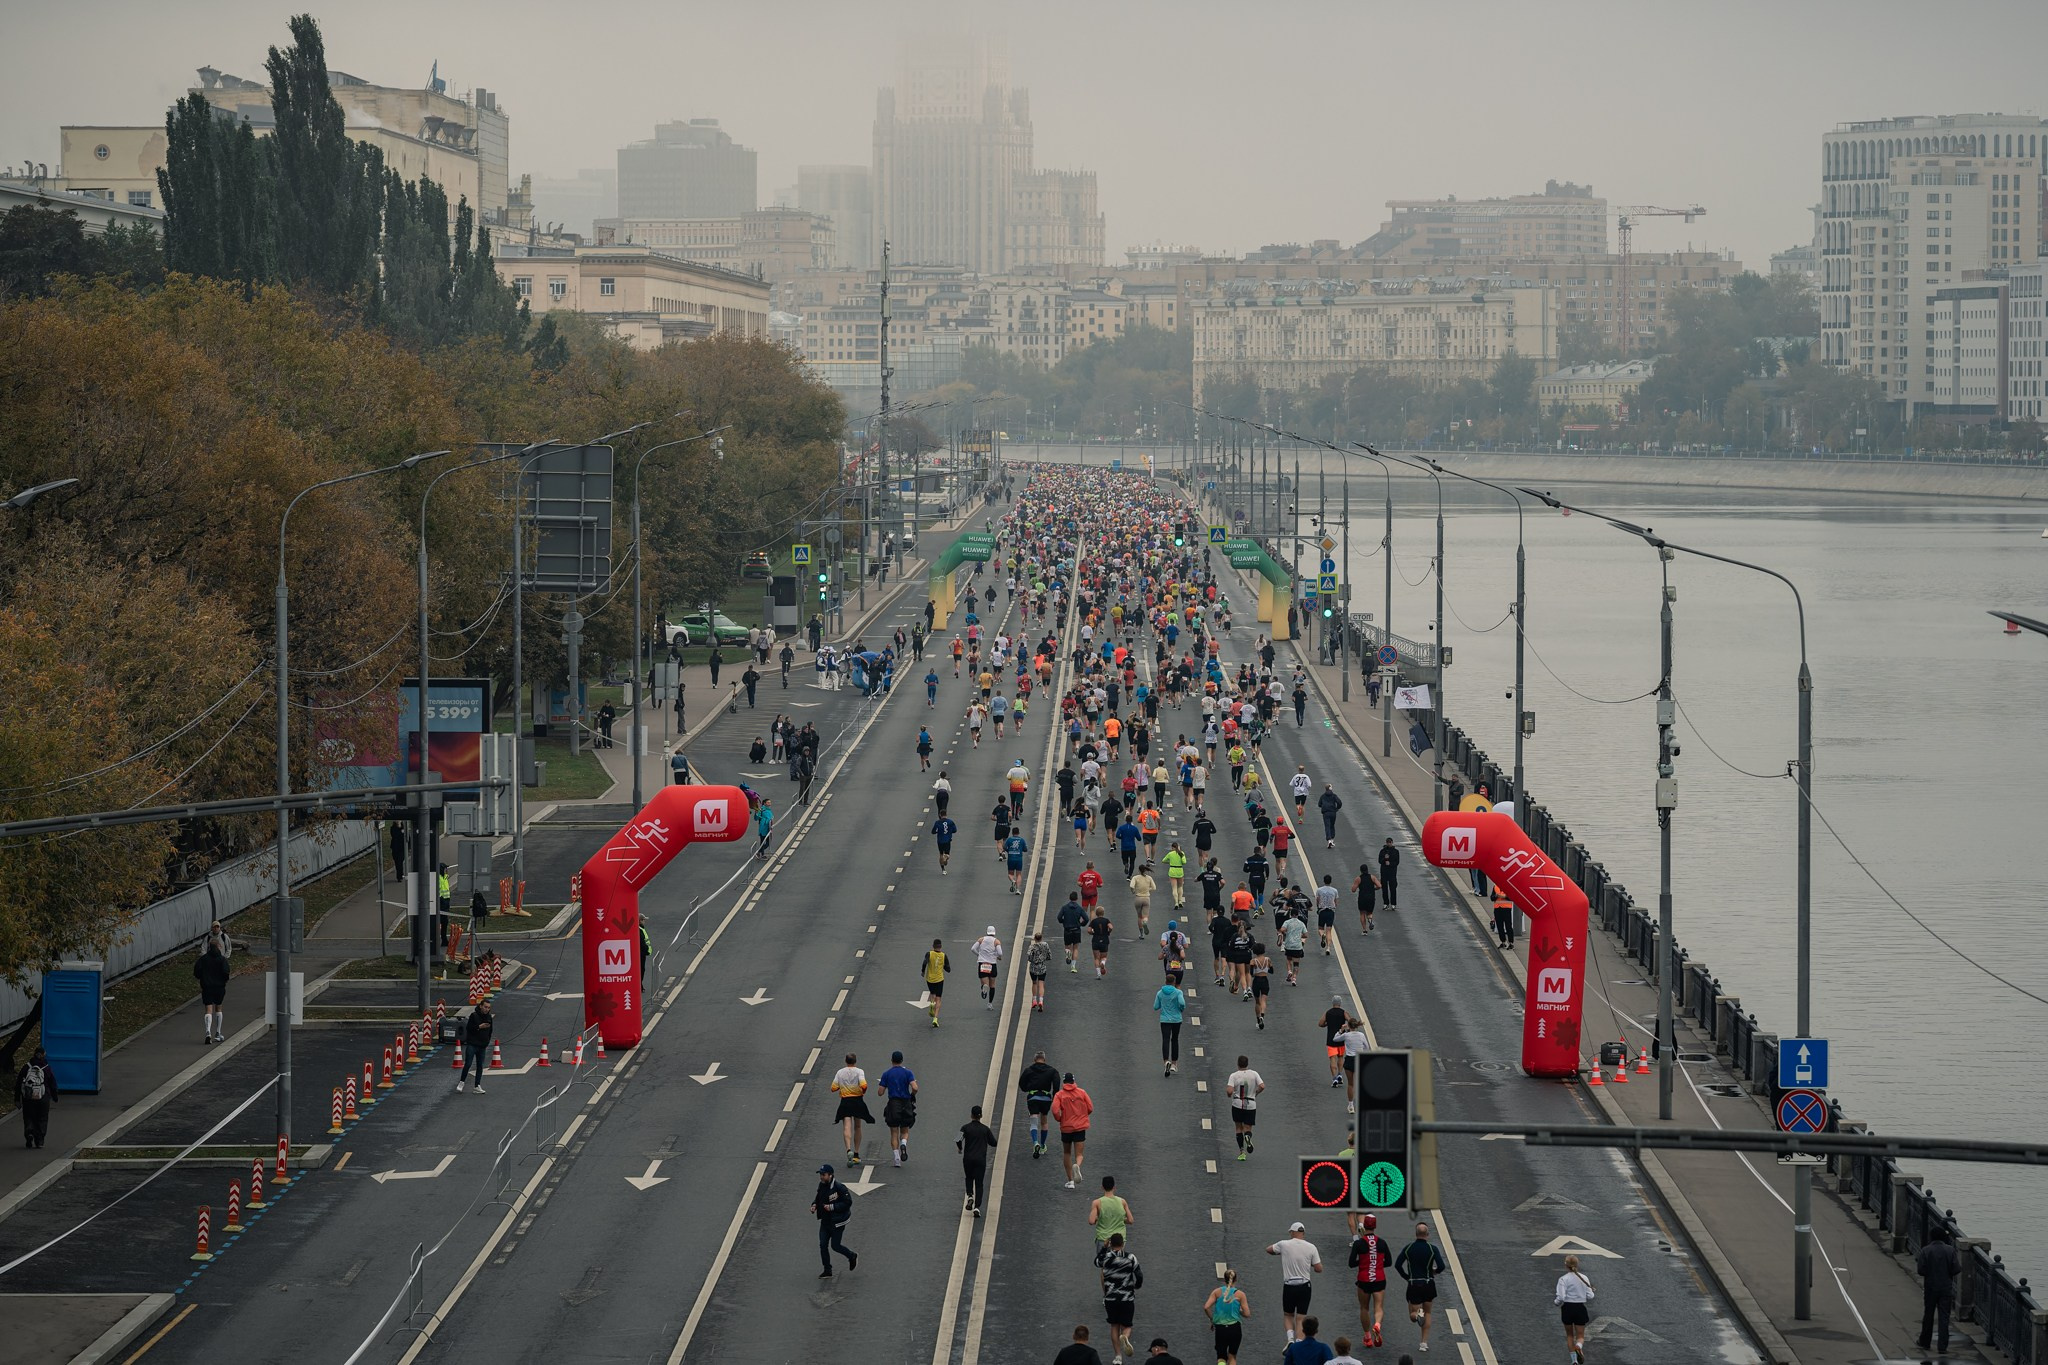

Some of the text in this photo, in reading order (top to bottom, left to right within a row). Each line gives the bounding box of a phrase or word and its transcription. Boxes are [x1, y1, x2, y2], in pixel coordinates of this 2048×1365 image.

[439, 706, 471, 719] 399
[1294, 776, 1307, 788] 37
[700, 808, 721, 825] М
[1448, 835, 1469, 852] М
[604, 948, 626, 966] М
[1544, 976, 1566, 994] М
